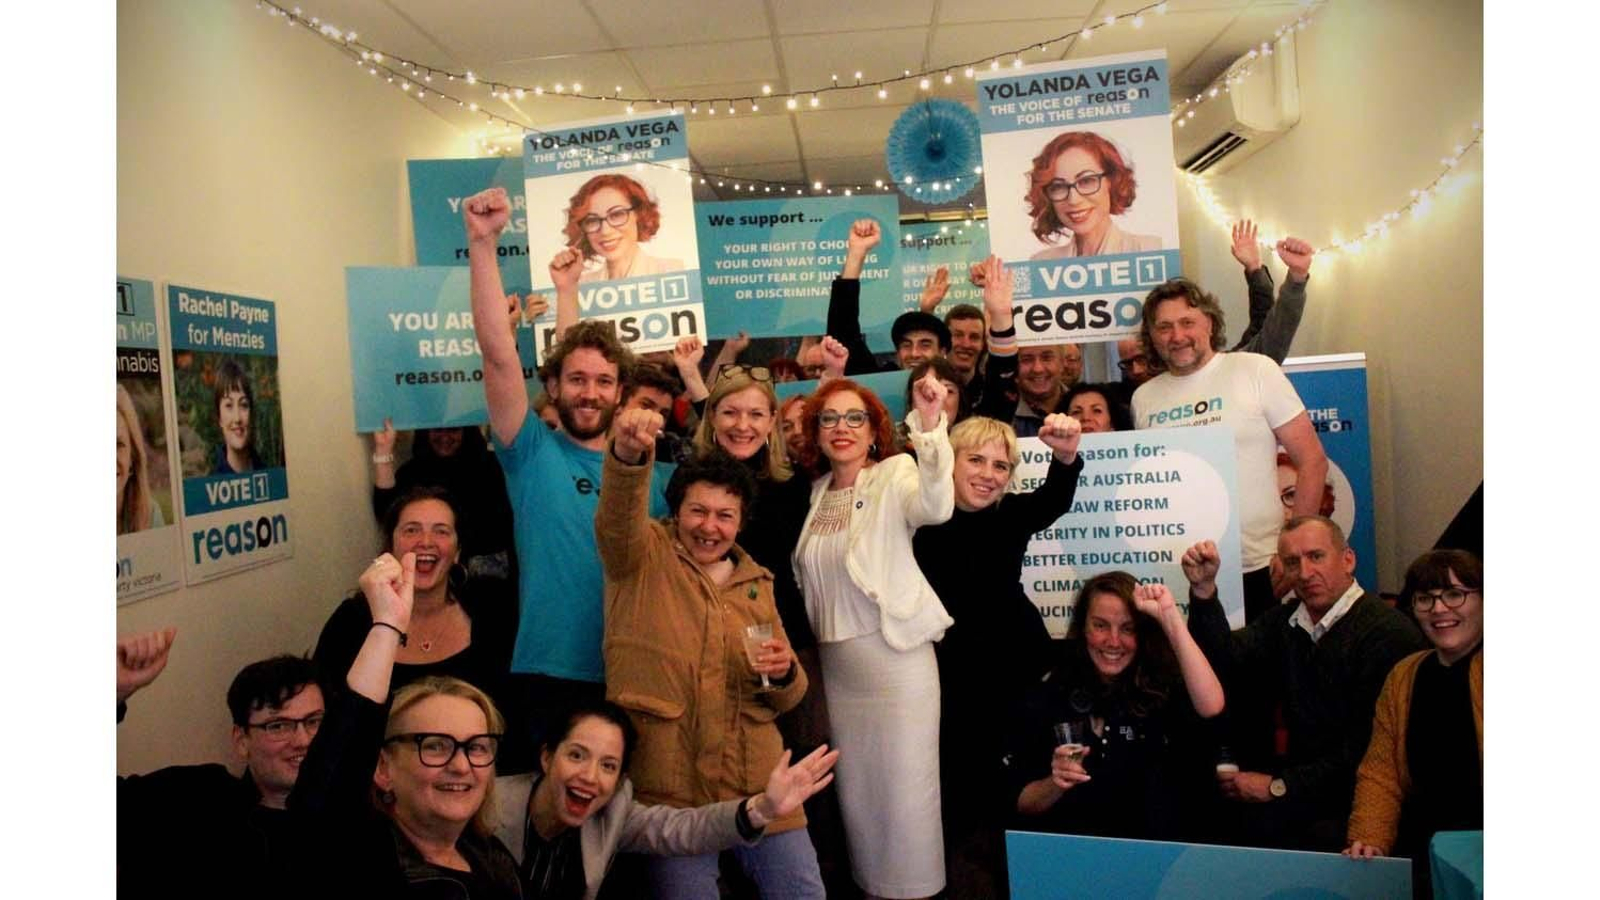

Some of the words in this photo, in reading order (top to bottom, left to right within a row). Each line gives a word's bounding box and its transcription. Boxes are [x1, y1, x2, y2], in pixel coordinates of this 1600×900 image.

[984, 74, 1091, 101] YOLANDA
[1097, 65, 1160, 88] VEGA
[989, 104, 1016, 116] THE
[1019, 98, 1060, 113] VOICE
[1063, 95, 1082, 107] OF
[1087, 86, 1150, 105] reason
[1017, 112, 1045, 126] FOR
[1048, 108, 1074, 122] THE
[1077, 102, 1131, 119] SENATE
[530, 127, 621, 151] YOLANDA
[626, 120, 679, 138] VEGA
[533, 152, 556, 163] THE
[558, 148, 593, 160] VOICE
[598, 144, 613, 155] OF
[617, 136, 671, 151] reason
[556, 160, 581, 171] FOR
[708, 214, 735, 227] We
[739, 211, 805, 229] support
[723, 243, 758, 255] YOUR
[760, 241, 798, 253] RIGHT
[800, 240, 817, 251] TO
[899, 235, 957, 251] support
[715, 258, 749, 270] YOUR
[751, 257, 785, 269] OWN
[786, 256, 815, 268] WAY
[817, 255, 833, 267] OF
[707, 273, 764, 286] WITHOUT
[767, 272, 797, 283] FEAR
[799, 270, 815, 282] OF
[817, 268, 890, 283] JUDMENT
[1038, 259, 1132, 291] VOTE
[577, 281, 658, 311] VOTE
[735, 290, 755, 300] OR
[757, 287, 833, 300] DISCRIMINA
[178, 292, 227, 317] Rachel
[230, 300, 269, 328] Payne
[1012, 296, 1144, 333] easo
[131, 321, 155, 342] MP
[389, 312, 438, 331] YOU
[444, 312, 474, 330] AR
[543, 308, 697, 349] rson
[187, 322, 210, 346] for
[211, 325, 266, 350] Menzies
[419, 338, 484, 358] REAS
[1147, 396, 1223, 428] reason
[1308, 407, 1339, 420] THE
[1021, 449, 1052, 464] Vot
[1078, 446, 1129, 461] eason
[1133, 443, 1167, 458] for:
[1021, 474, 1089, 491] SECR
[1093, 470, 1182, 487] AUSTRALIA
[206, 477, 252, 507] VOTE
[1068, 500, 1099, 514] AW
[1104, 497, 1169, 512] REFORM
[192, 511, 289, 565] reason
[1093, 525, 1110, 539] IN
[1115, 522, 1186, 538] POLITICS
[1023, 553, 1077, 567] BETTER
[1081, 550, 1173, 566] EDUCATION
[1033, 579, 1083, 593] CLIMA
